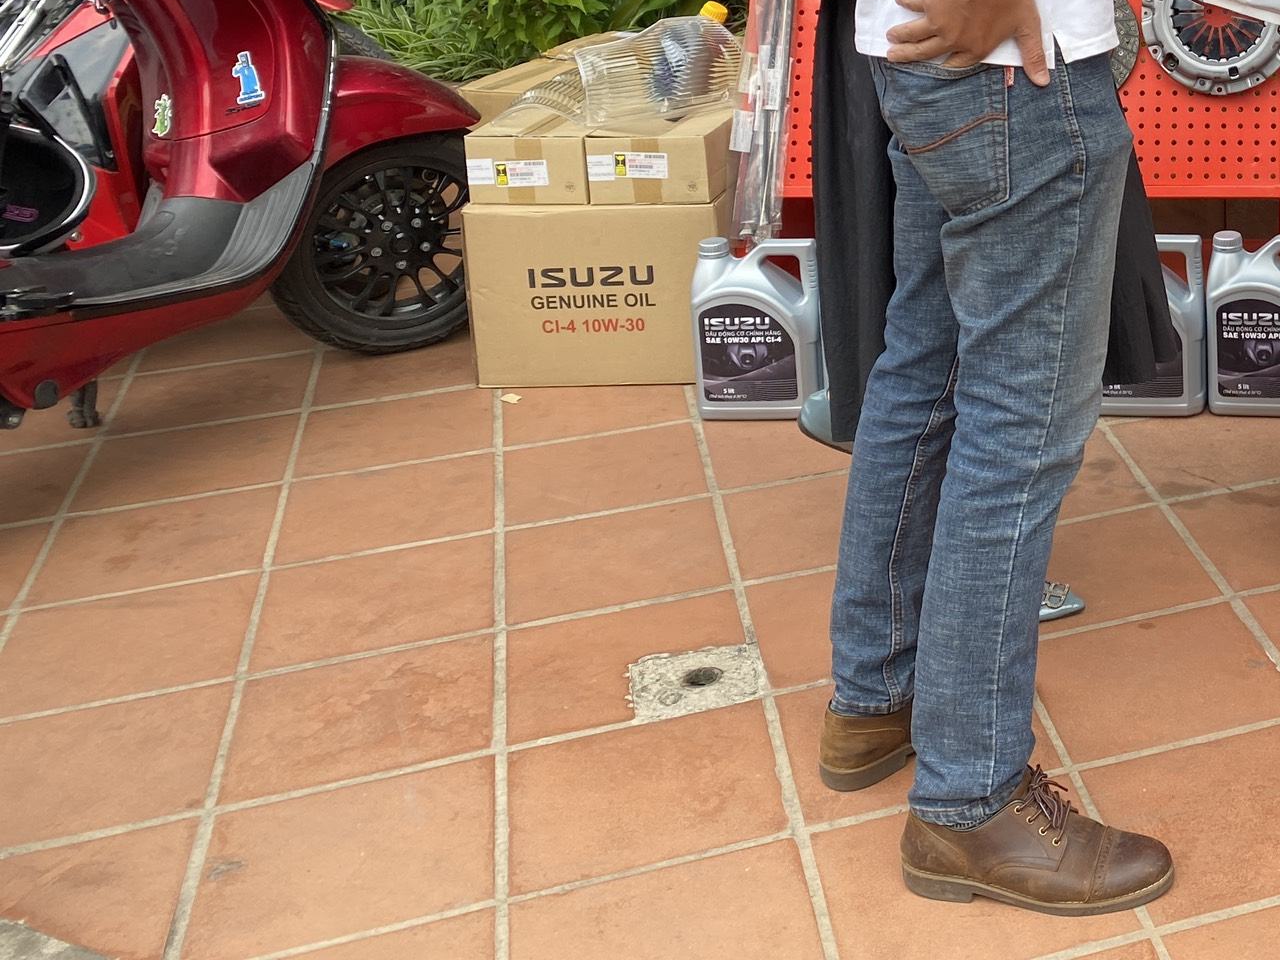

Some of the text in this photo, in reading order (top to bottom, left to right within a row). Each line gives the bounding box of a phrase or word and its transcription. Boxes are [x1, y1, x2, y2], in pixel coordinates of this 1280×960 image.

[527, 265, 655, 289] ISUZU
[530, 292, 657, 310] GENUINE OIL
[542, 317, 646, 334] CI-4 10W-30
[703, 316, 770, 331] ISUZU
